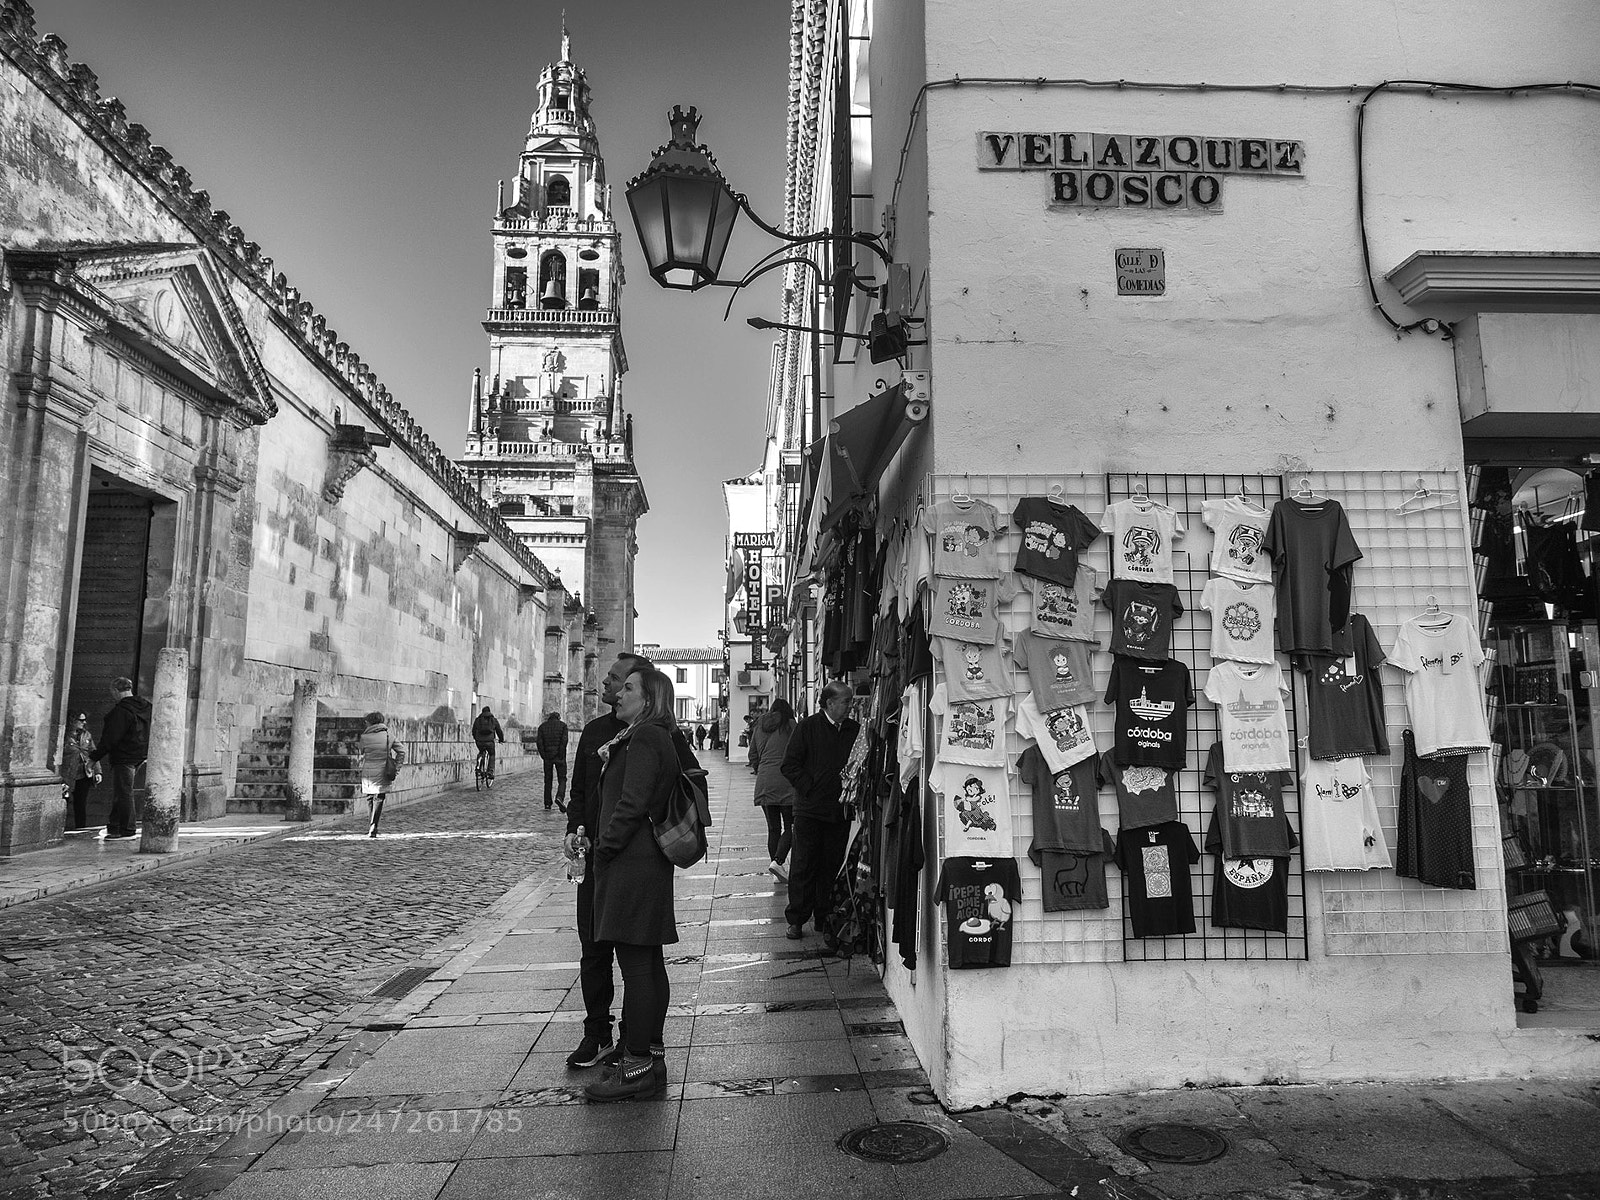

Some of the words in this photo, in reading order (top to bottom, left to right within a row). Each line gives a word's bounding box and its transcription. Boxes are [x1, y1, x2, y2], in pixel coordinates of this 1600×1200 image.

[985, 134, 1300, 172] VELAZQUEZ
[1050, 171, 1220, 205] BOSCO
[735, 533, 774, 547] MARISA
[748, 549, 761, 627] HOTEL
[767, 587, 782, 603] P
[1127, 726, 1172, 741] córdoba
[1230, 727, 1282, 741] córdoba
[981, 795, 996, 806] olé!
[1229, 868, 1265, 884] ESPAÑA
